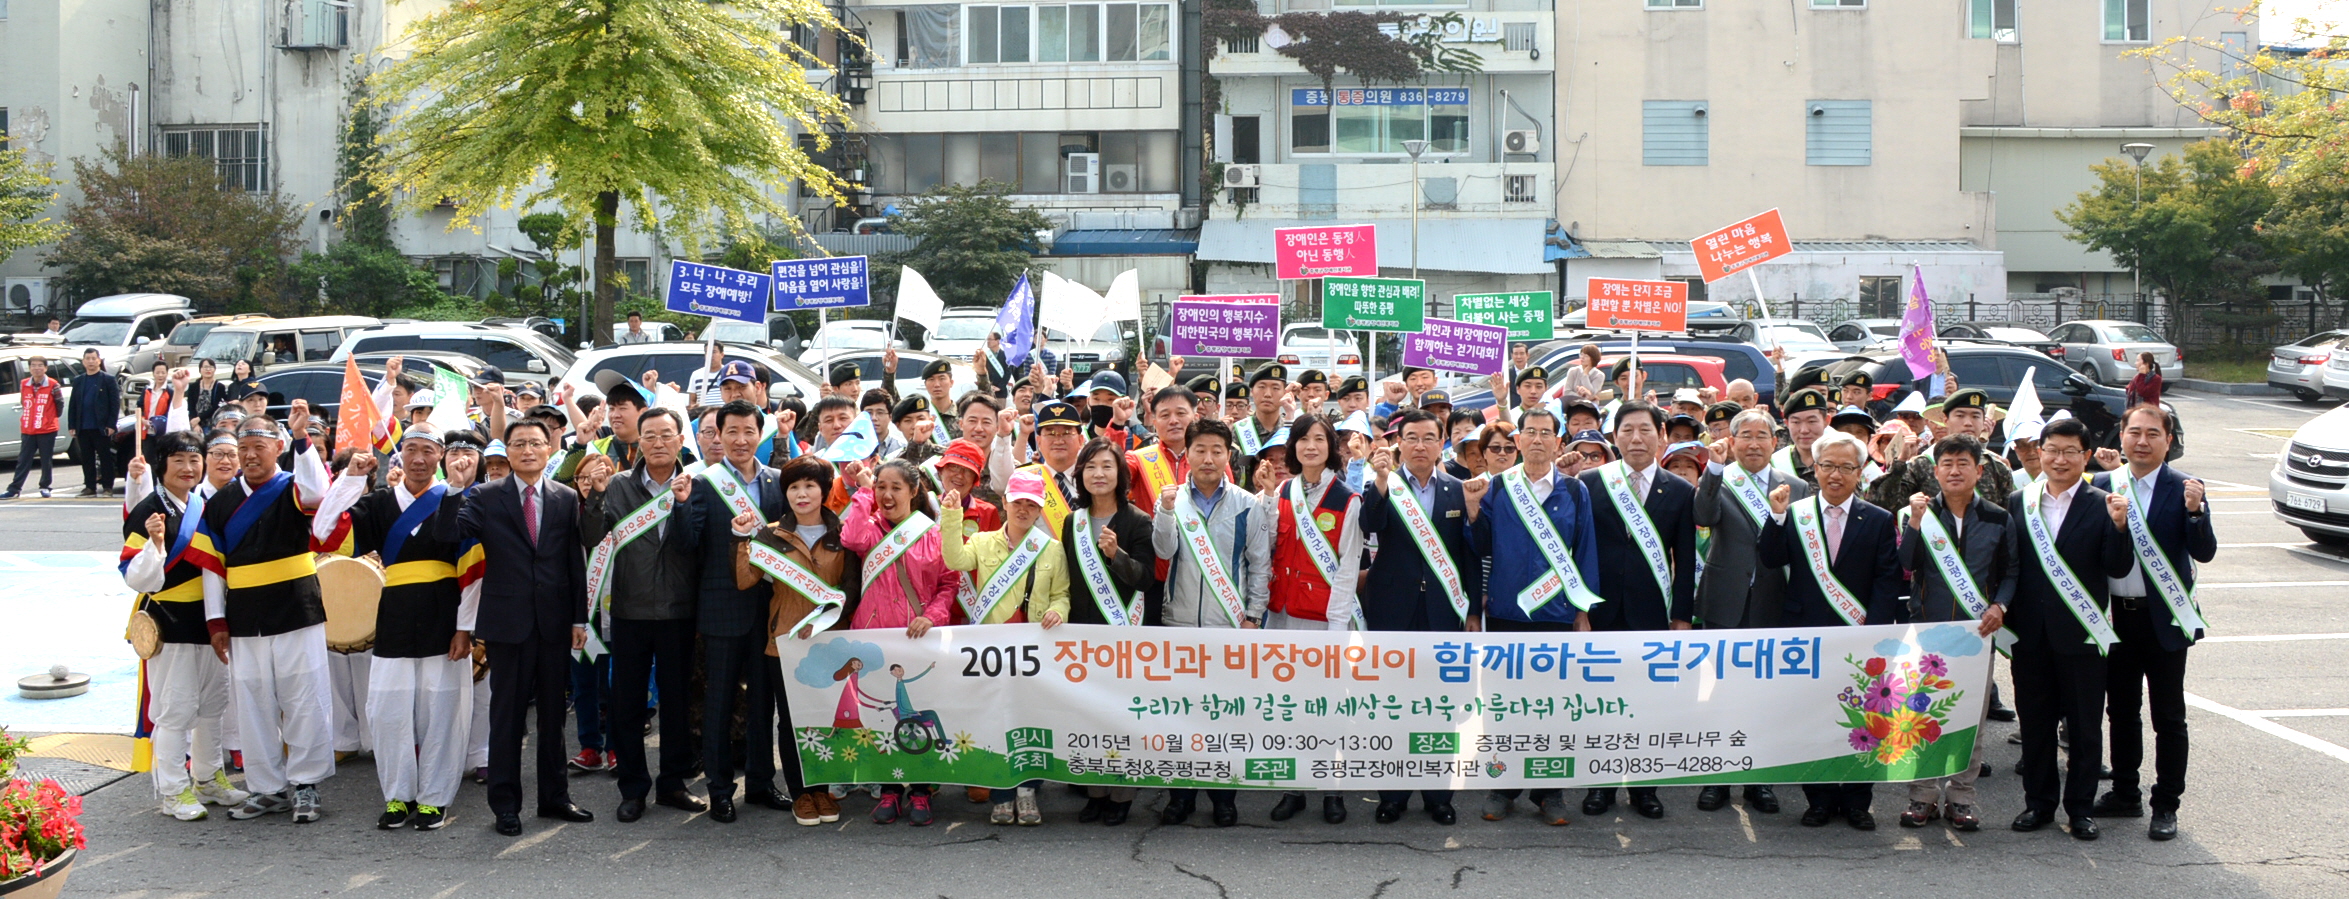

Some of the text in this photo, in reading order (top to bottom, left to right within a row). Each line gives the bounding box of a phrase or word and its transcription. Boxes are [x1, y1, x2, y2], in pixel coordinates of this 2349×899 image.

[1337, 90, 1392, 105] 통증의원
[1400, 91, 1465, 102] 836-8279
[1285, 232, 1329, 247] 장애인은
[1705, 223, 1756, 250] 열린 마음
[1296, 248, 1319, 262] 아닌
[1710, 232, 1773, 262] 나누는 행복
[777, 260, 863, 278] 편견을 넘어 관심을!
[679, 281, 753, 303] 모두 장애예방!
[778, 276, 864, 294] 마음을 열어 사랑을!
[1328, 283, 1420, 299] 장애인을 향한 관심과 배려!
[1602, 282, 1673, 299] 장애는 단지 조금
[1354, 301, 1394, 315] 따뜻한 증평
[1461, 294, 1531, 310] 차별없는 세상
[1591, 298, 1682, 314] 불편할 뿐 차별은 NO!
[1177, 308, 1220, 322] 장애인의
[1497, 311, 1520, 324] 사는
[1522, 310, 1545, 323] 증평
[1176, 326, 1274, 341] 대한민국의 행복지수
[1453, 327, 1503, 345] 비장애인이
[1414, 338, 1499, 360] 함께하는 걷기대회!
[725, 361, 739, 376] A
[2304, 496, 2321, 510] 6729
[960, 636, 1821, 683] 2015 장애인과 비장애인이 함께하는 걷기대회
[1128, 693, 1635, 722] 우리가 함께 걸을 때 세상은 더욱 아름다워 집니다.
[1010, 729, 1748, 754] 일시 2015년 10월 8일(목) 09:30~13:00 장소 증평군청 및 보강천 미루나무 숲
[1013, 752, 1753, 780] 주최 충북도청&증평군청 주관 증평군장애인복지관 문의 043)835-4288~9
